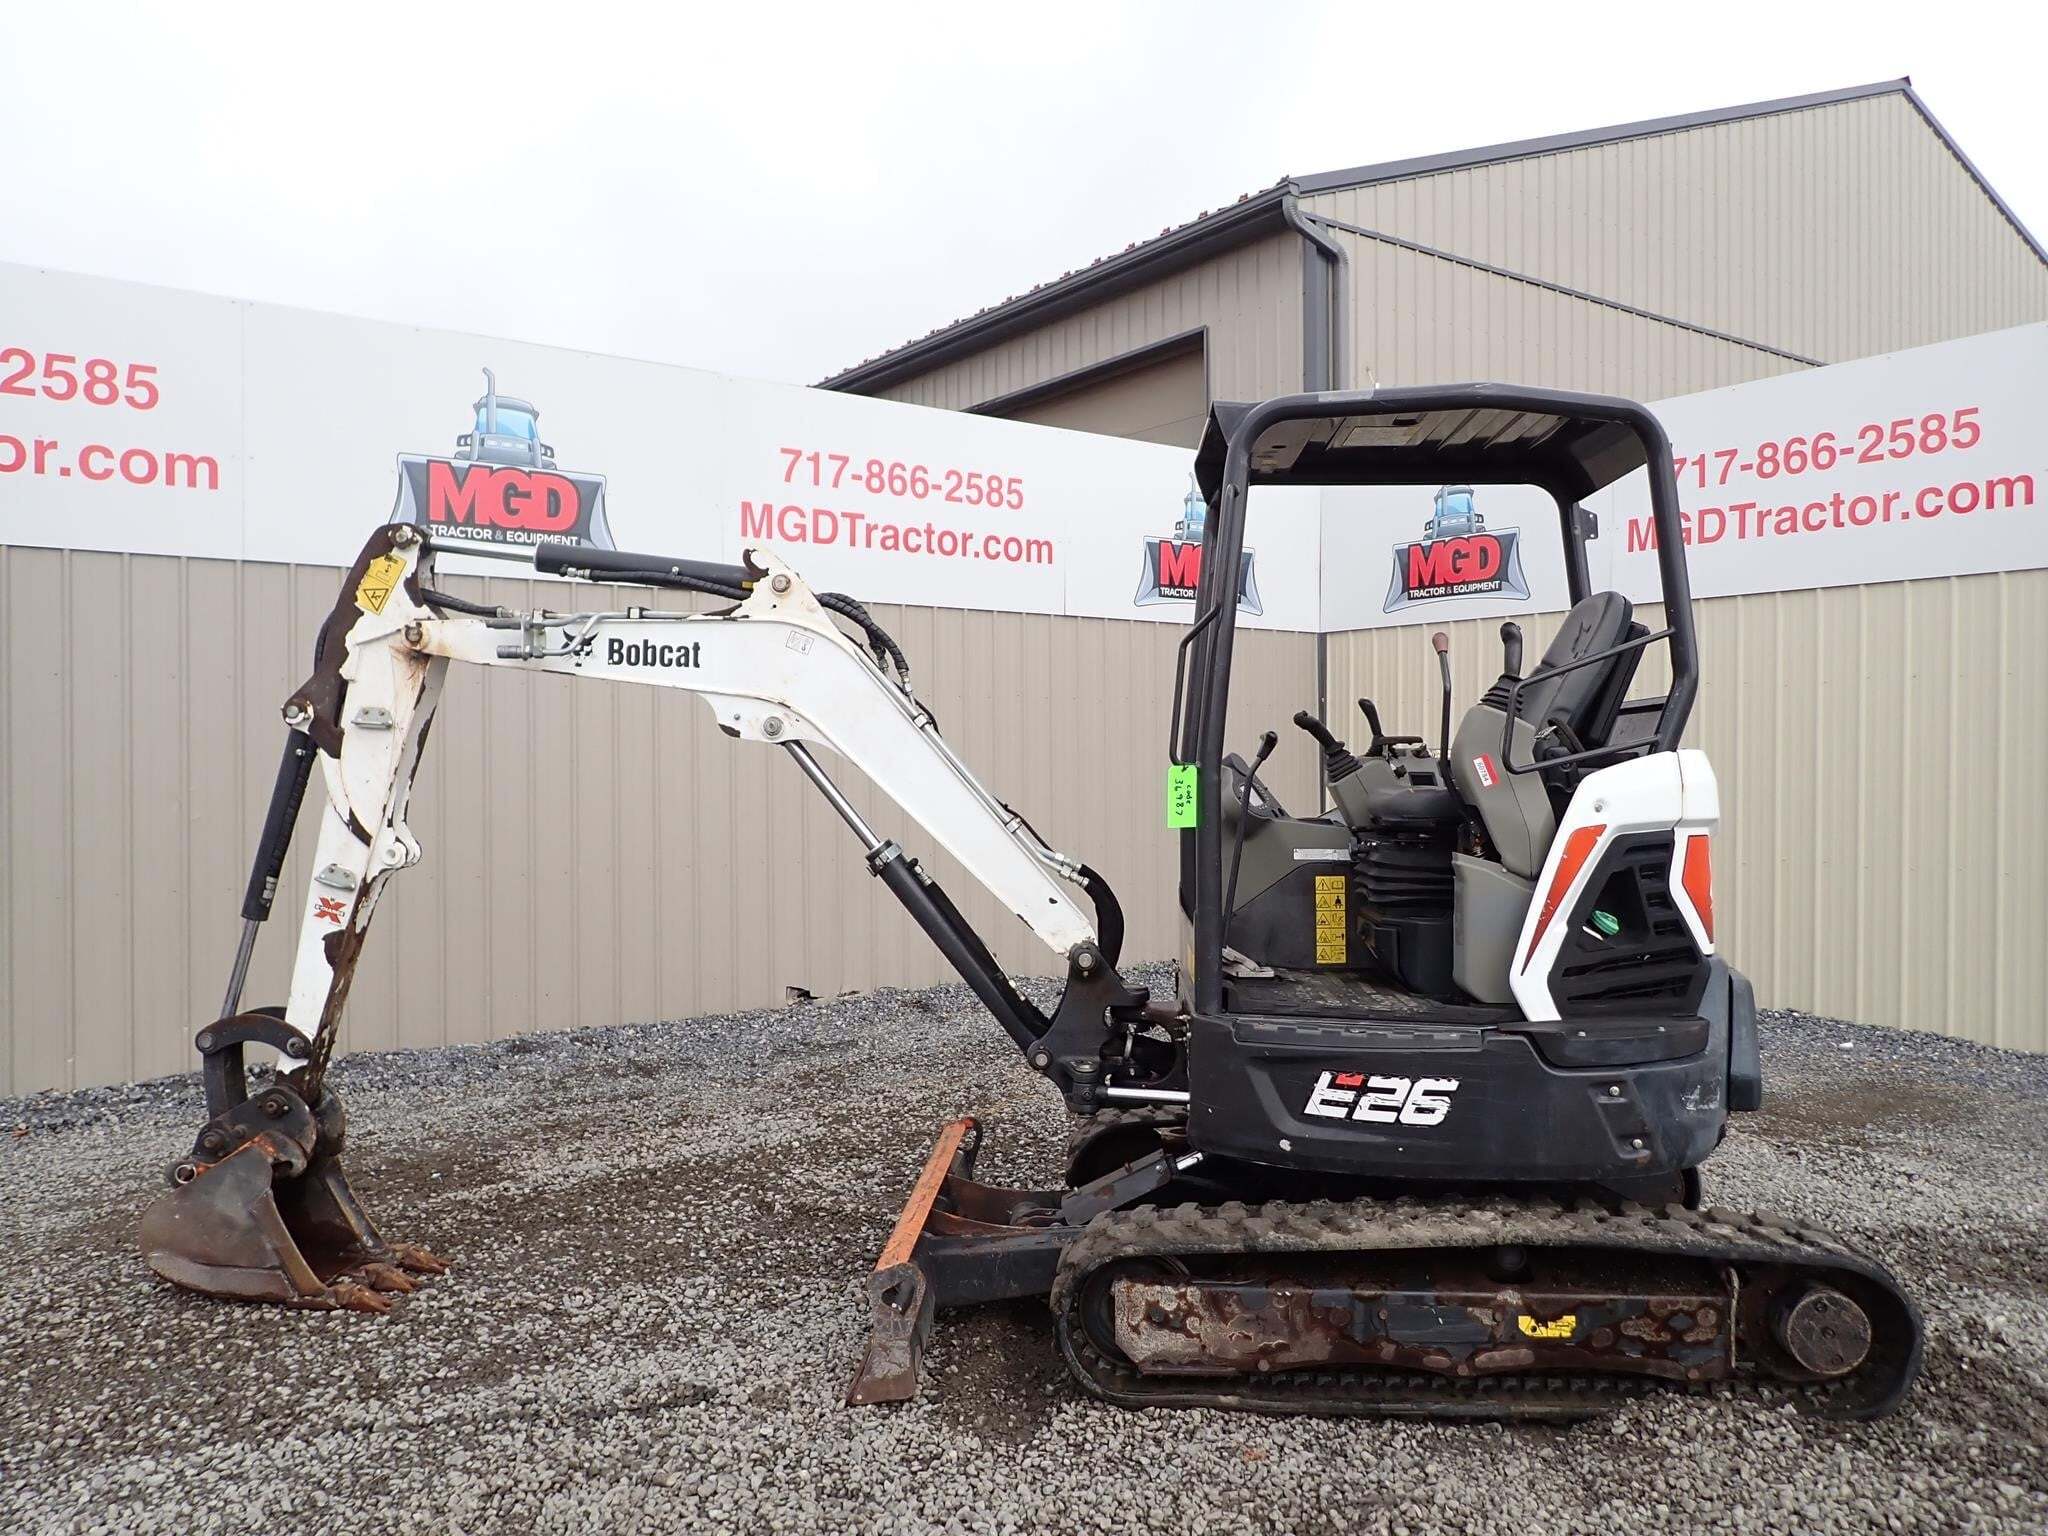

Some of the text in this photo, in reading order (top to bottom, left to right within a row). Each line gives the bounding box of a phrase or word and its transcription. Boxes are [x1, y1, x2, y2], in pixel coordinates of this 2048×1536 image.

[0, 348, 159, 410] 2585
[428, 461, 581, 532] MGD
[780, 447, 1024, 510] 717-866-2585
[430, 524, 578, 546] TRACTOR & EQUIPMENT
[740, 501, 1053, 565] MGDTractor.com
[1410, 535, 1501, 587] MGD
[1160, 587, 1194, 597] TRACTOR
[1409, 587, 1445, 598] TRACTOR
[1453, 581, 1501, 594] EQUIPMENT
[608, 638, 701, 668] Bobcat
[1304, 1070, 1460, 1126] E26
